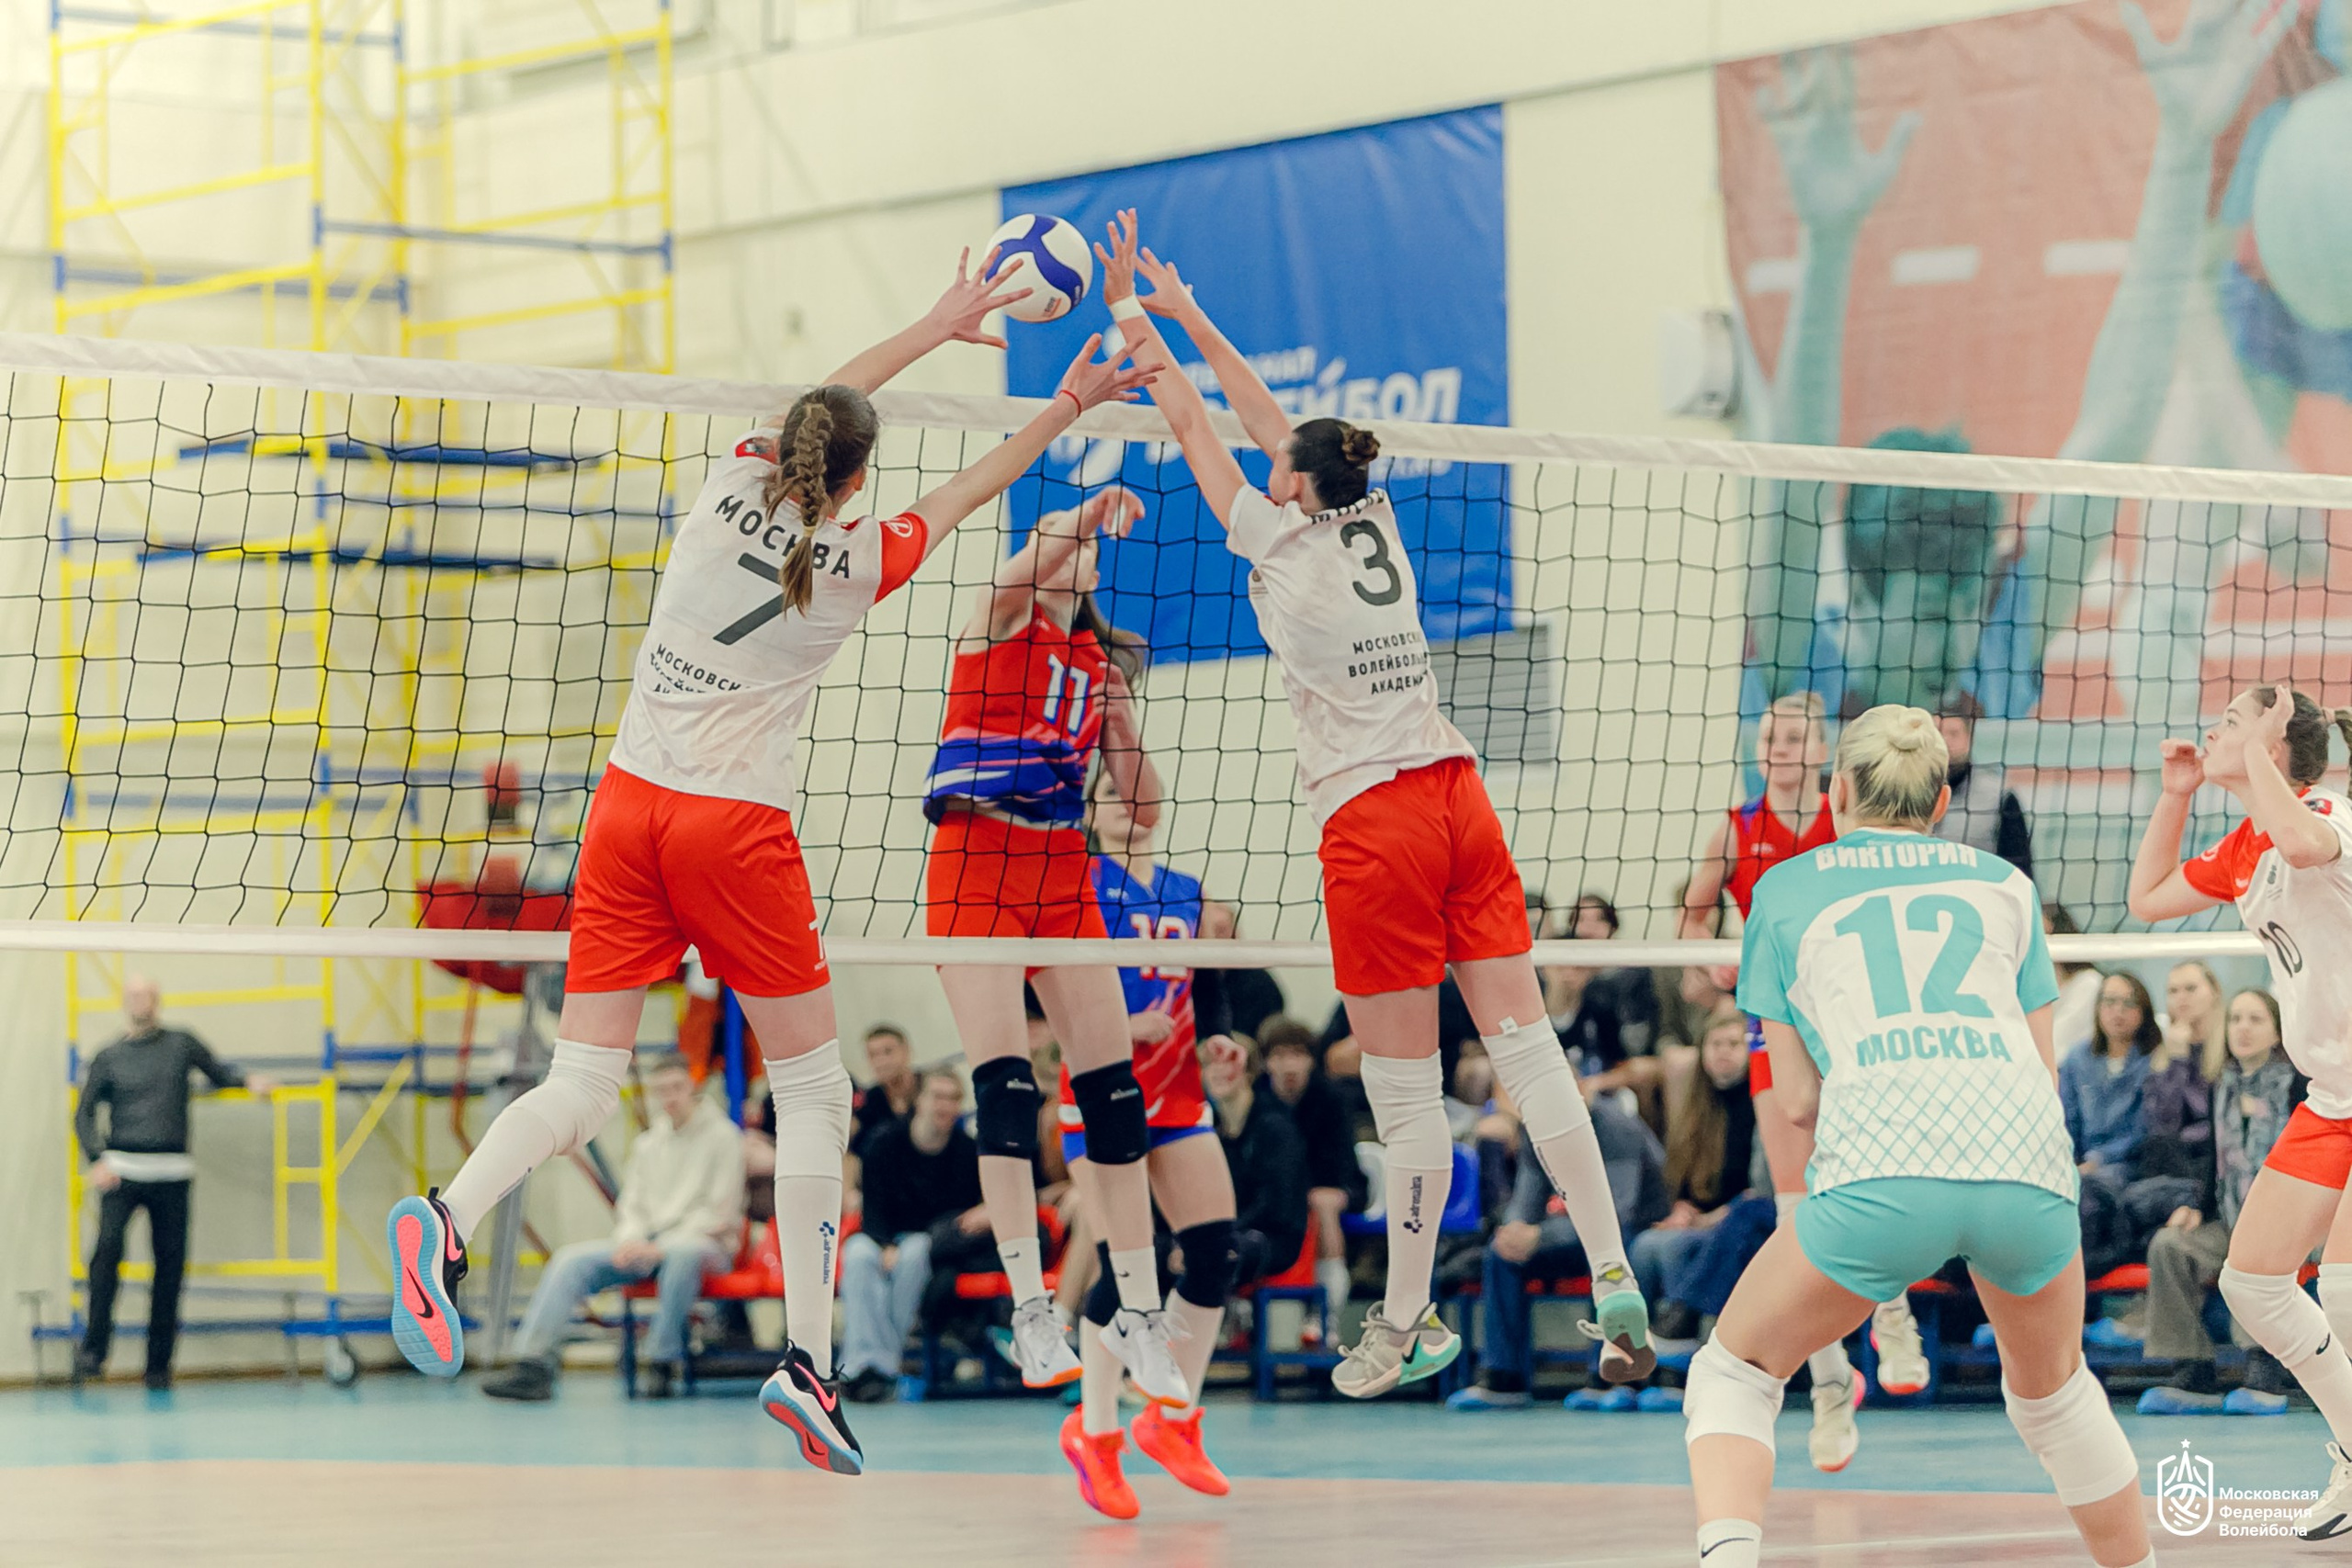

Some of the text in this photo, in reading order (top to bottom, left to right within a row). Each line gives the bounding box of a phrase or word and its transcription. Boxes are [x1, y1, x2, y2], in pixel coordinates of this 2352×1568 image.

[713, 553, 797, 646] 7
[1340, 519, 1402, 606] 3
[1044, 653, 1091, 738] 11
[1815, 841, 1978, 872] ВИКТОРИЯ
[1834, 894, 1996, 1020] 12
[1856, 1025, 2014, 1067] МОСКВА
